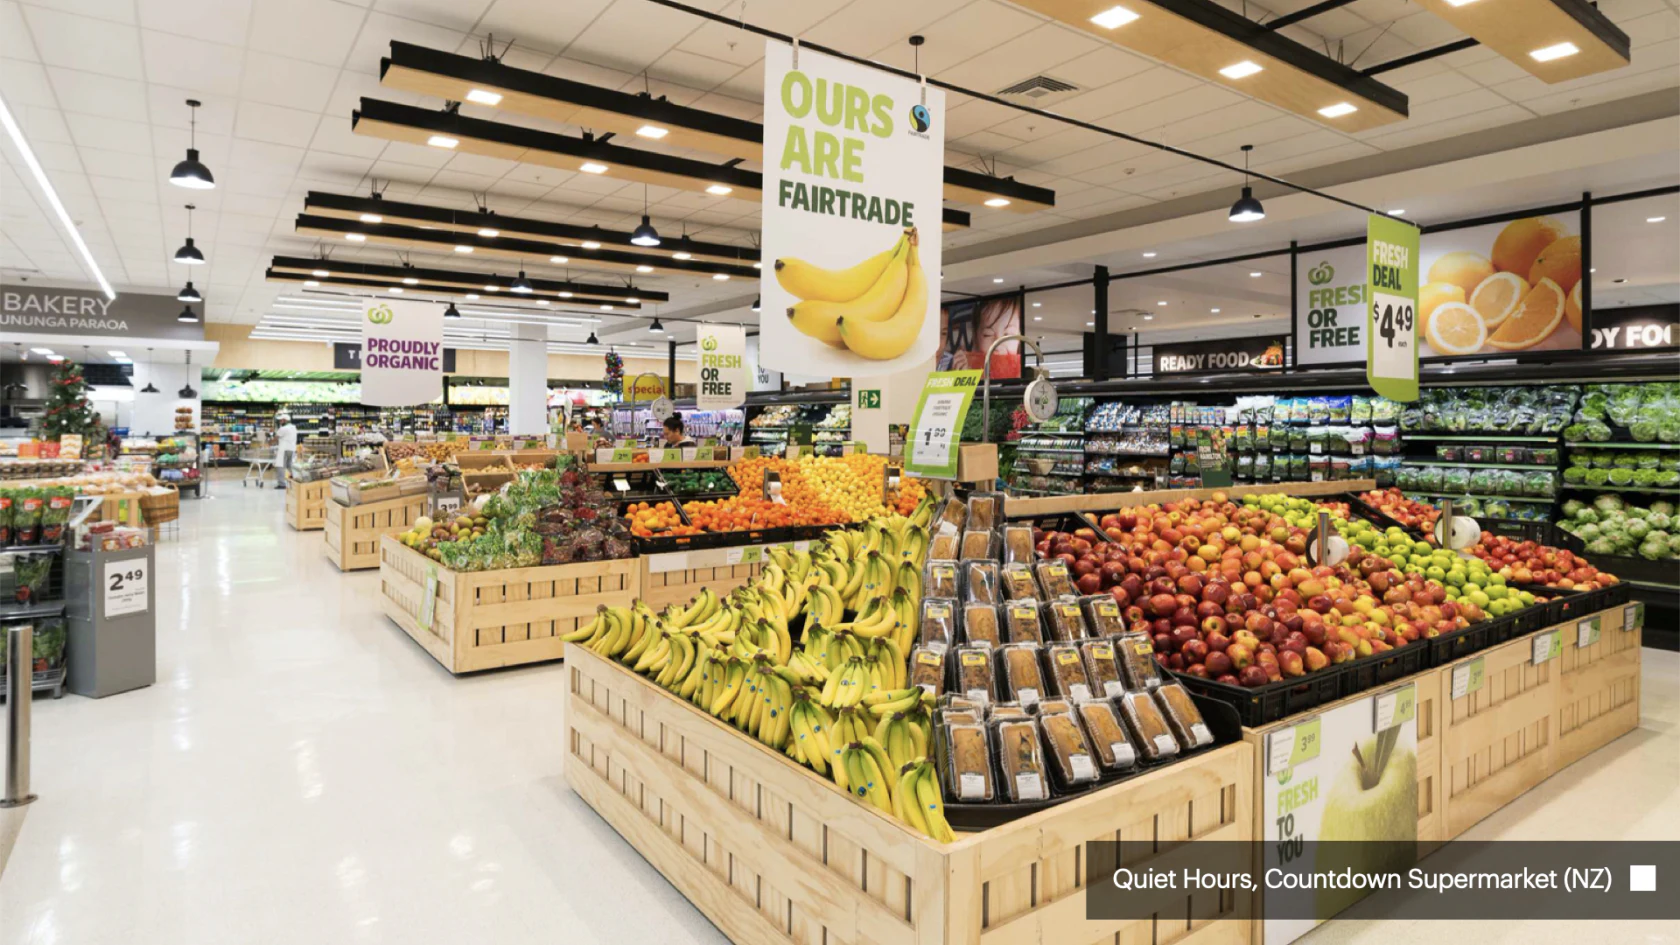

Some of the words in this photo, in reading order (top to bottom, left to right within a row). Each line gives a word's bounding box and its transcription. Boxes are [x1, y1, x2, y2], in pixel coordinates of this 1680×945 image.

[780, 70, 895, 139] OURS
[780, 124, 865, 183] ARE
[778, 178, 915, 228] FAIRTRADE
[1373, 239, 1409, 269] FRESH
[1373, 263, 1402, 291] DEAL
[4, 292, 114, 316] BAKERY
[69, 317, 128, 330] PARAOA
[1307, 308, 1338, 329] OR
[367, 338, 440, 355] PROUDLY
[1309, 326, 1360, 349] FREE
[366, 353, 439, 370] ORGANIC
[702, 354, 742, 368] FRESH
[1160, 353, 1205, 371] READY
[1208, 351, 1249, 369] FOOD
[701, 367, 719, 381] OR
[757, 374, 769, 384] YOU
[925, 377, 954, 388] FRESH
[953, 376, 977, 387] DEAL
[702, 382, 732, 395] FREE
[1277, 776, 1319, 817] FRESH
[1276, 813, 1295, 841] TO
[1276, 833, 1304, 866] YOU
